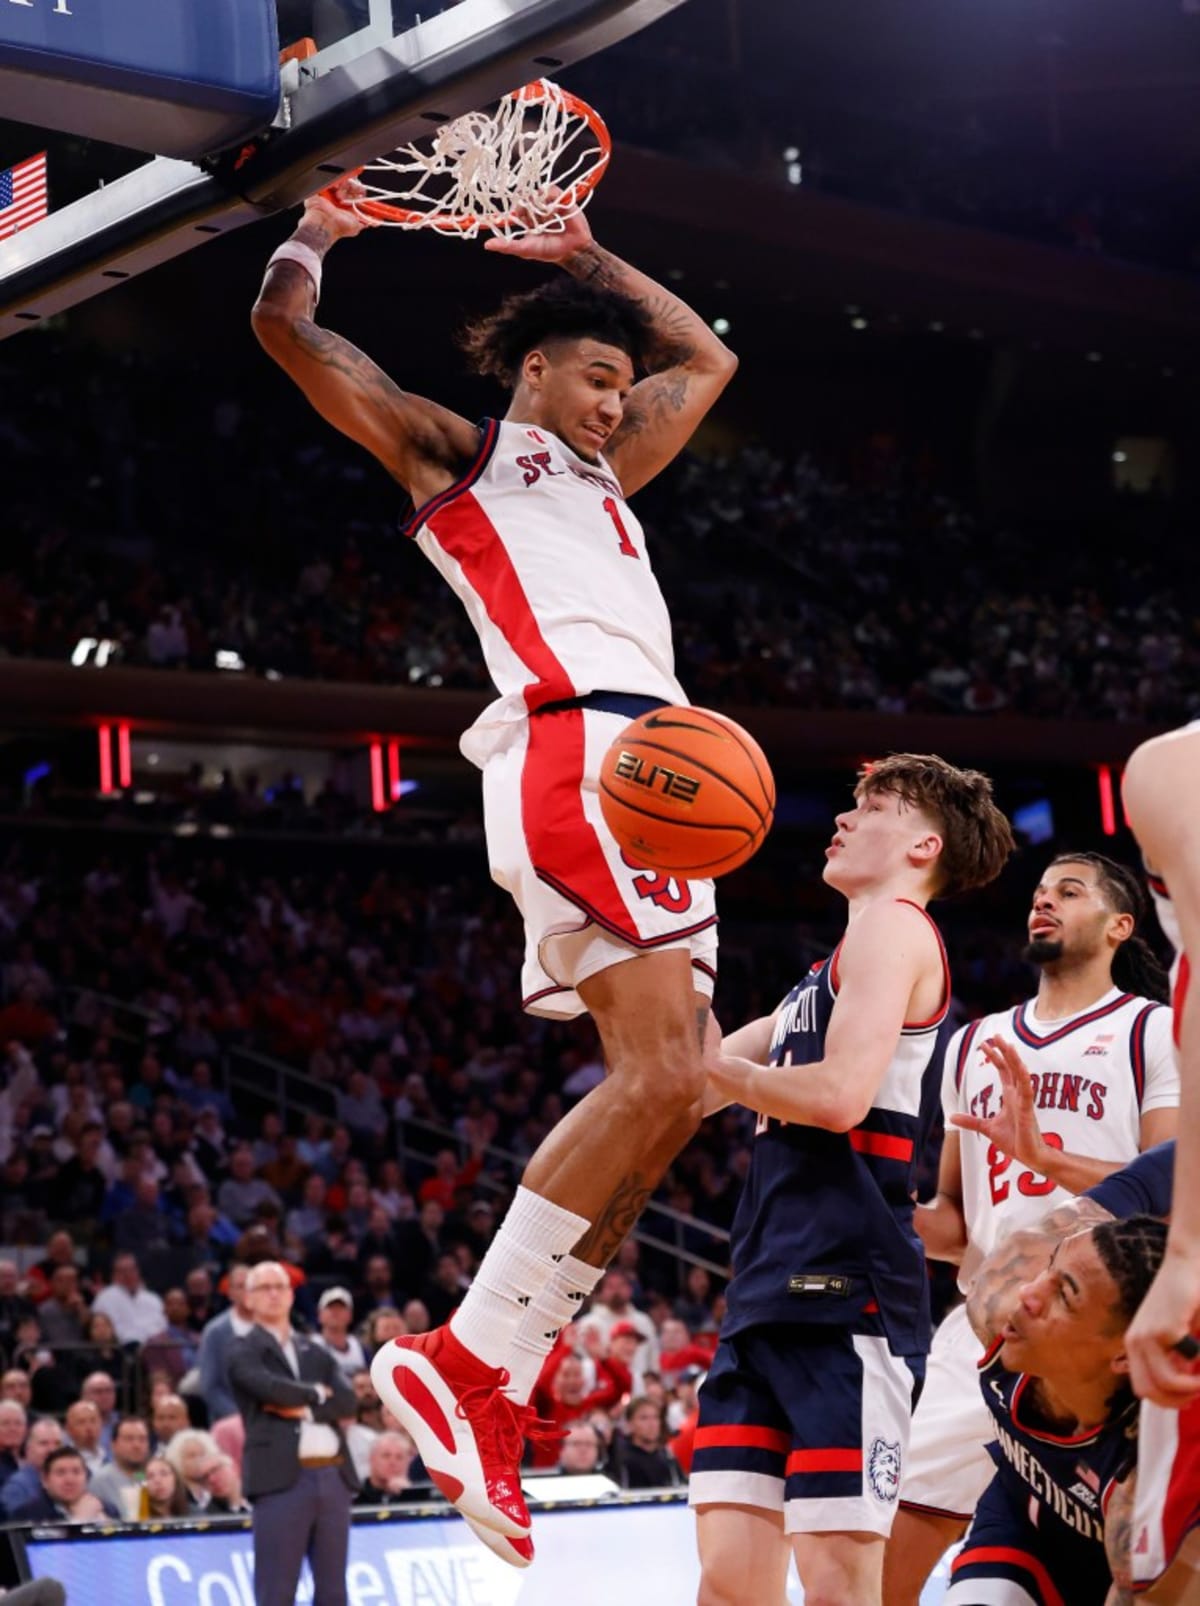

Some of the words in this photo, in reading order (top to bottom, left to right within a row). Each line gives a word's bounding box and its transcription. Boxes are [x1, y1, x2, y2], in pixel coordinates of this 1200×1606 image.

[602, 496, 640, 560] 1
[614, 750, 701, 803] ELITE
[1001, 1072, 1107, 1120] OHN'S
